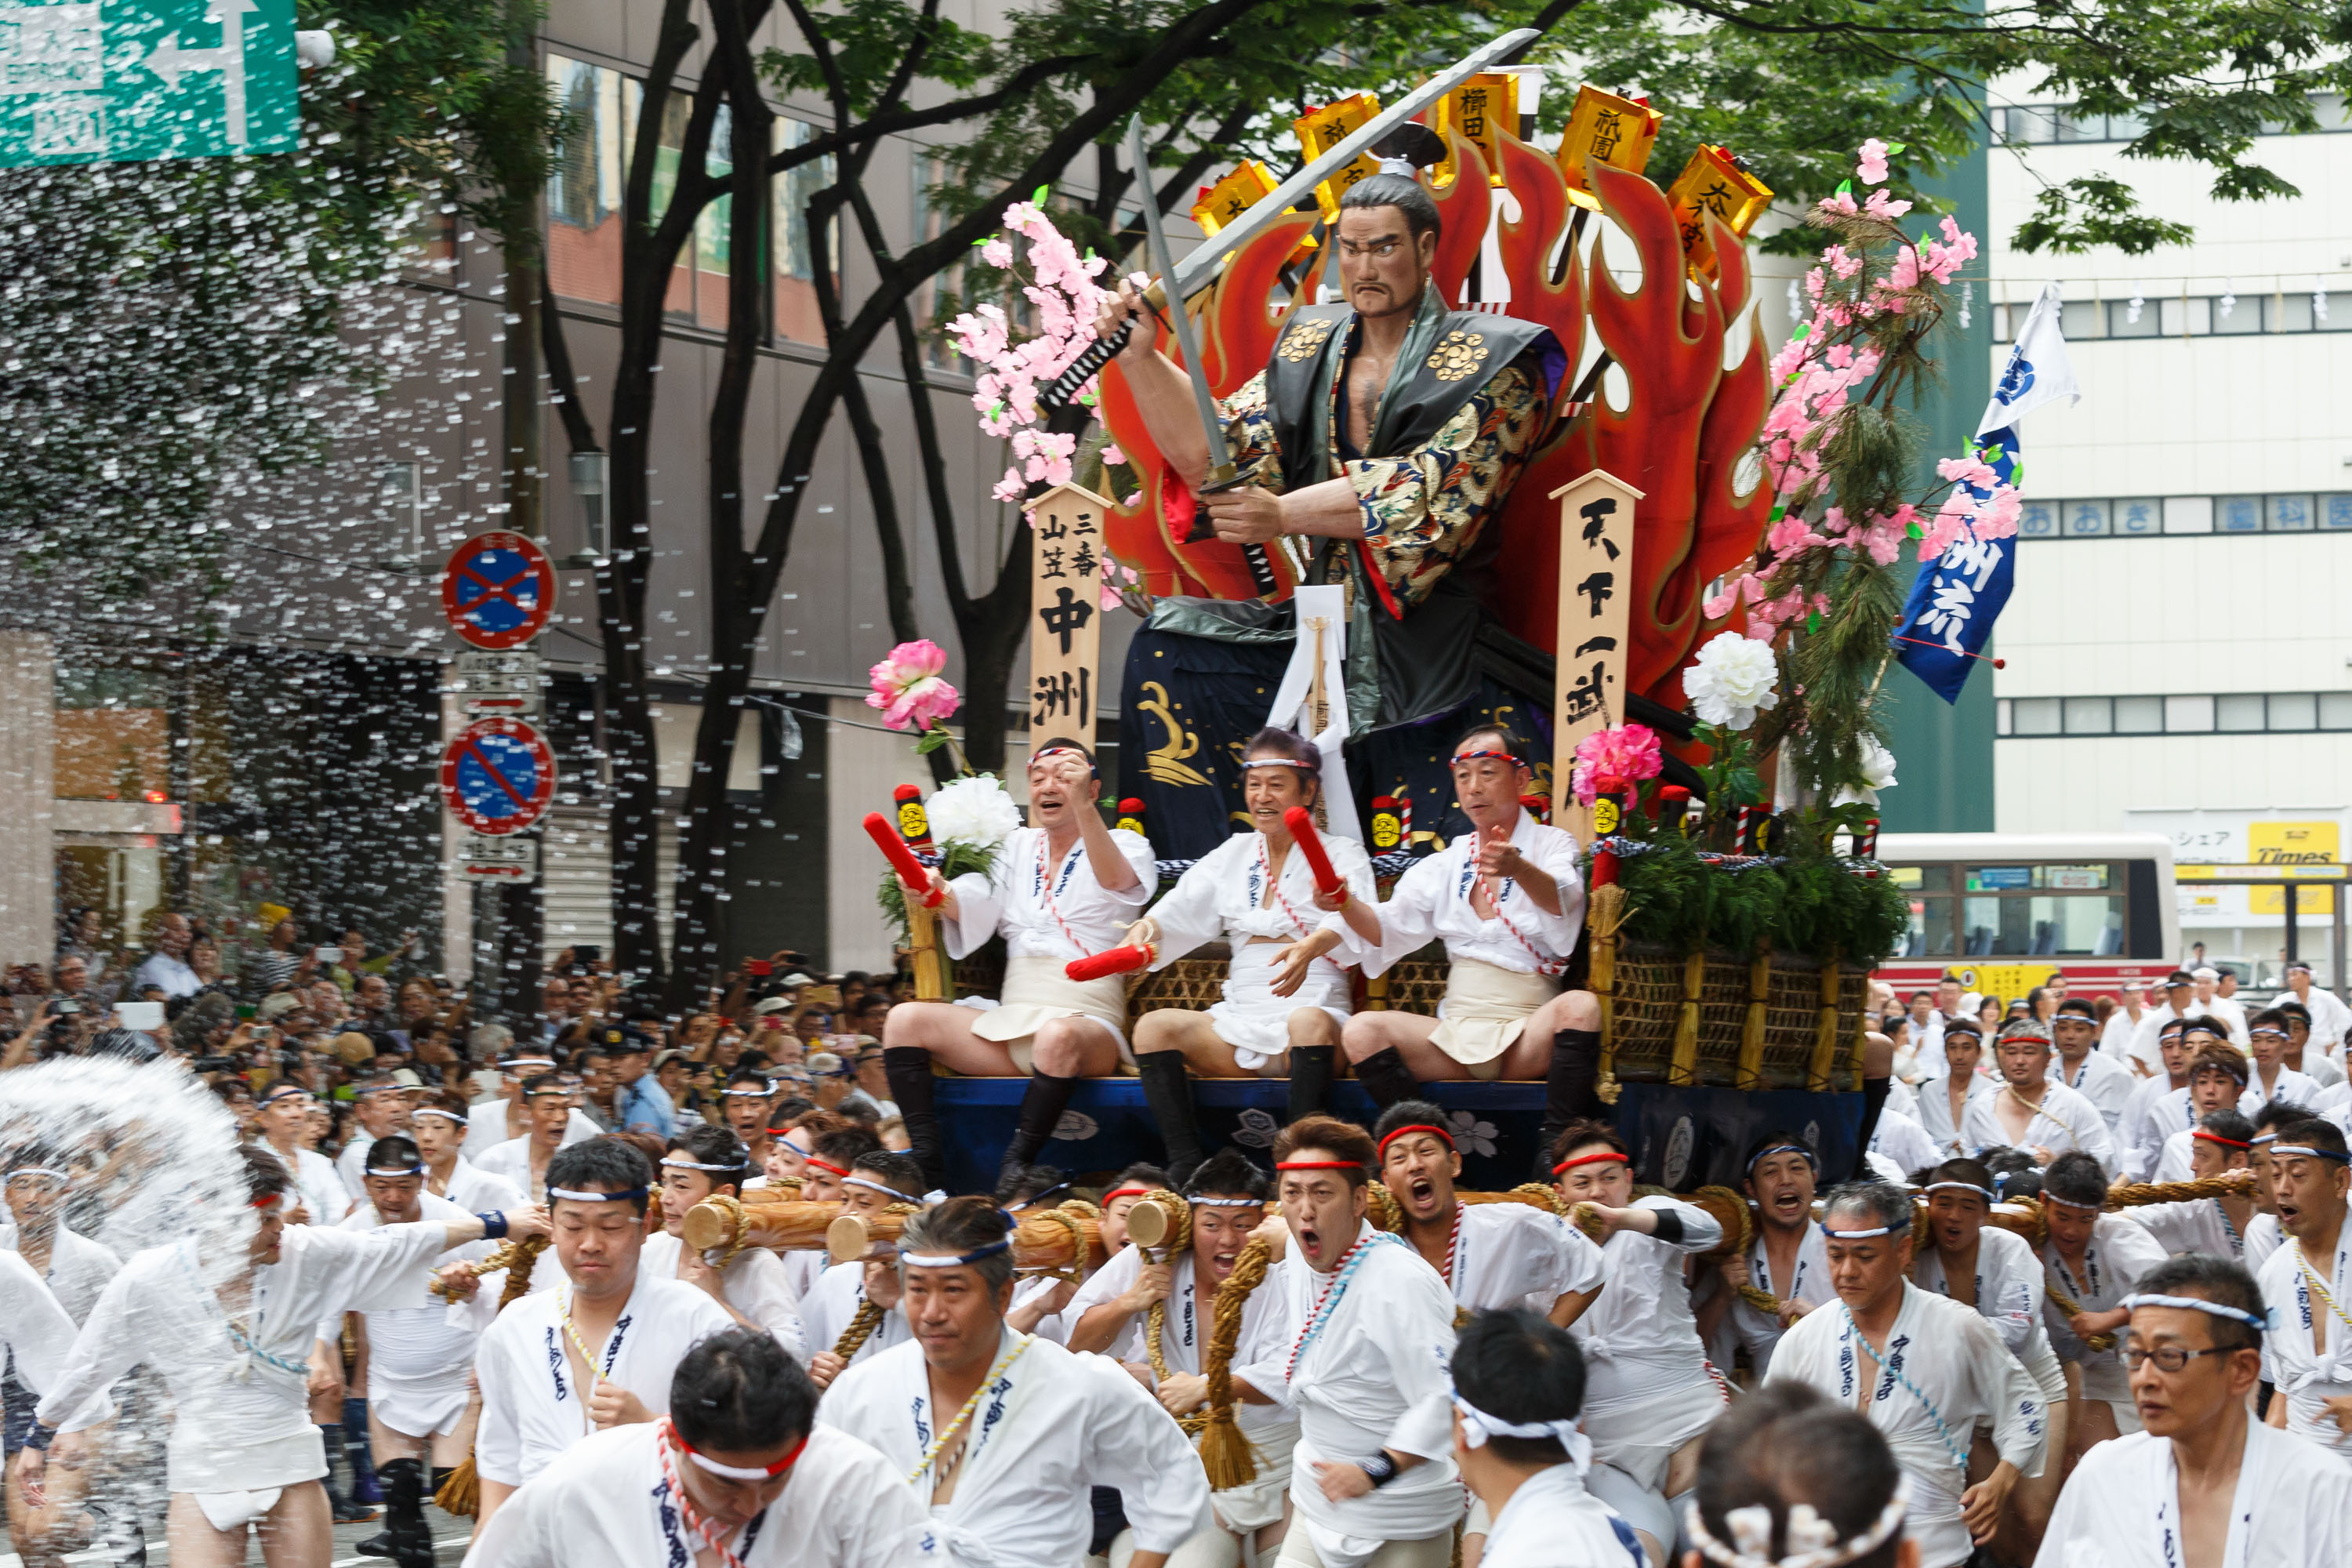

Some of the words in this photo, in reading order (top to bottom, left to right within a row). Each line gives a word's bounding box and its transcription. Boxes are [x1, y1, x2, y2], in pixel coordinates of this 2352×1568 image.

[1040, 514, 1068, 580] 山笠
[1069, 514, 1098, 578] 三番
[1033, 586, 1093, 730] 中洲
[1566, 496, 1621, 808] 天下一武
